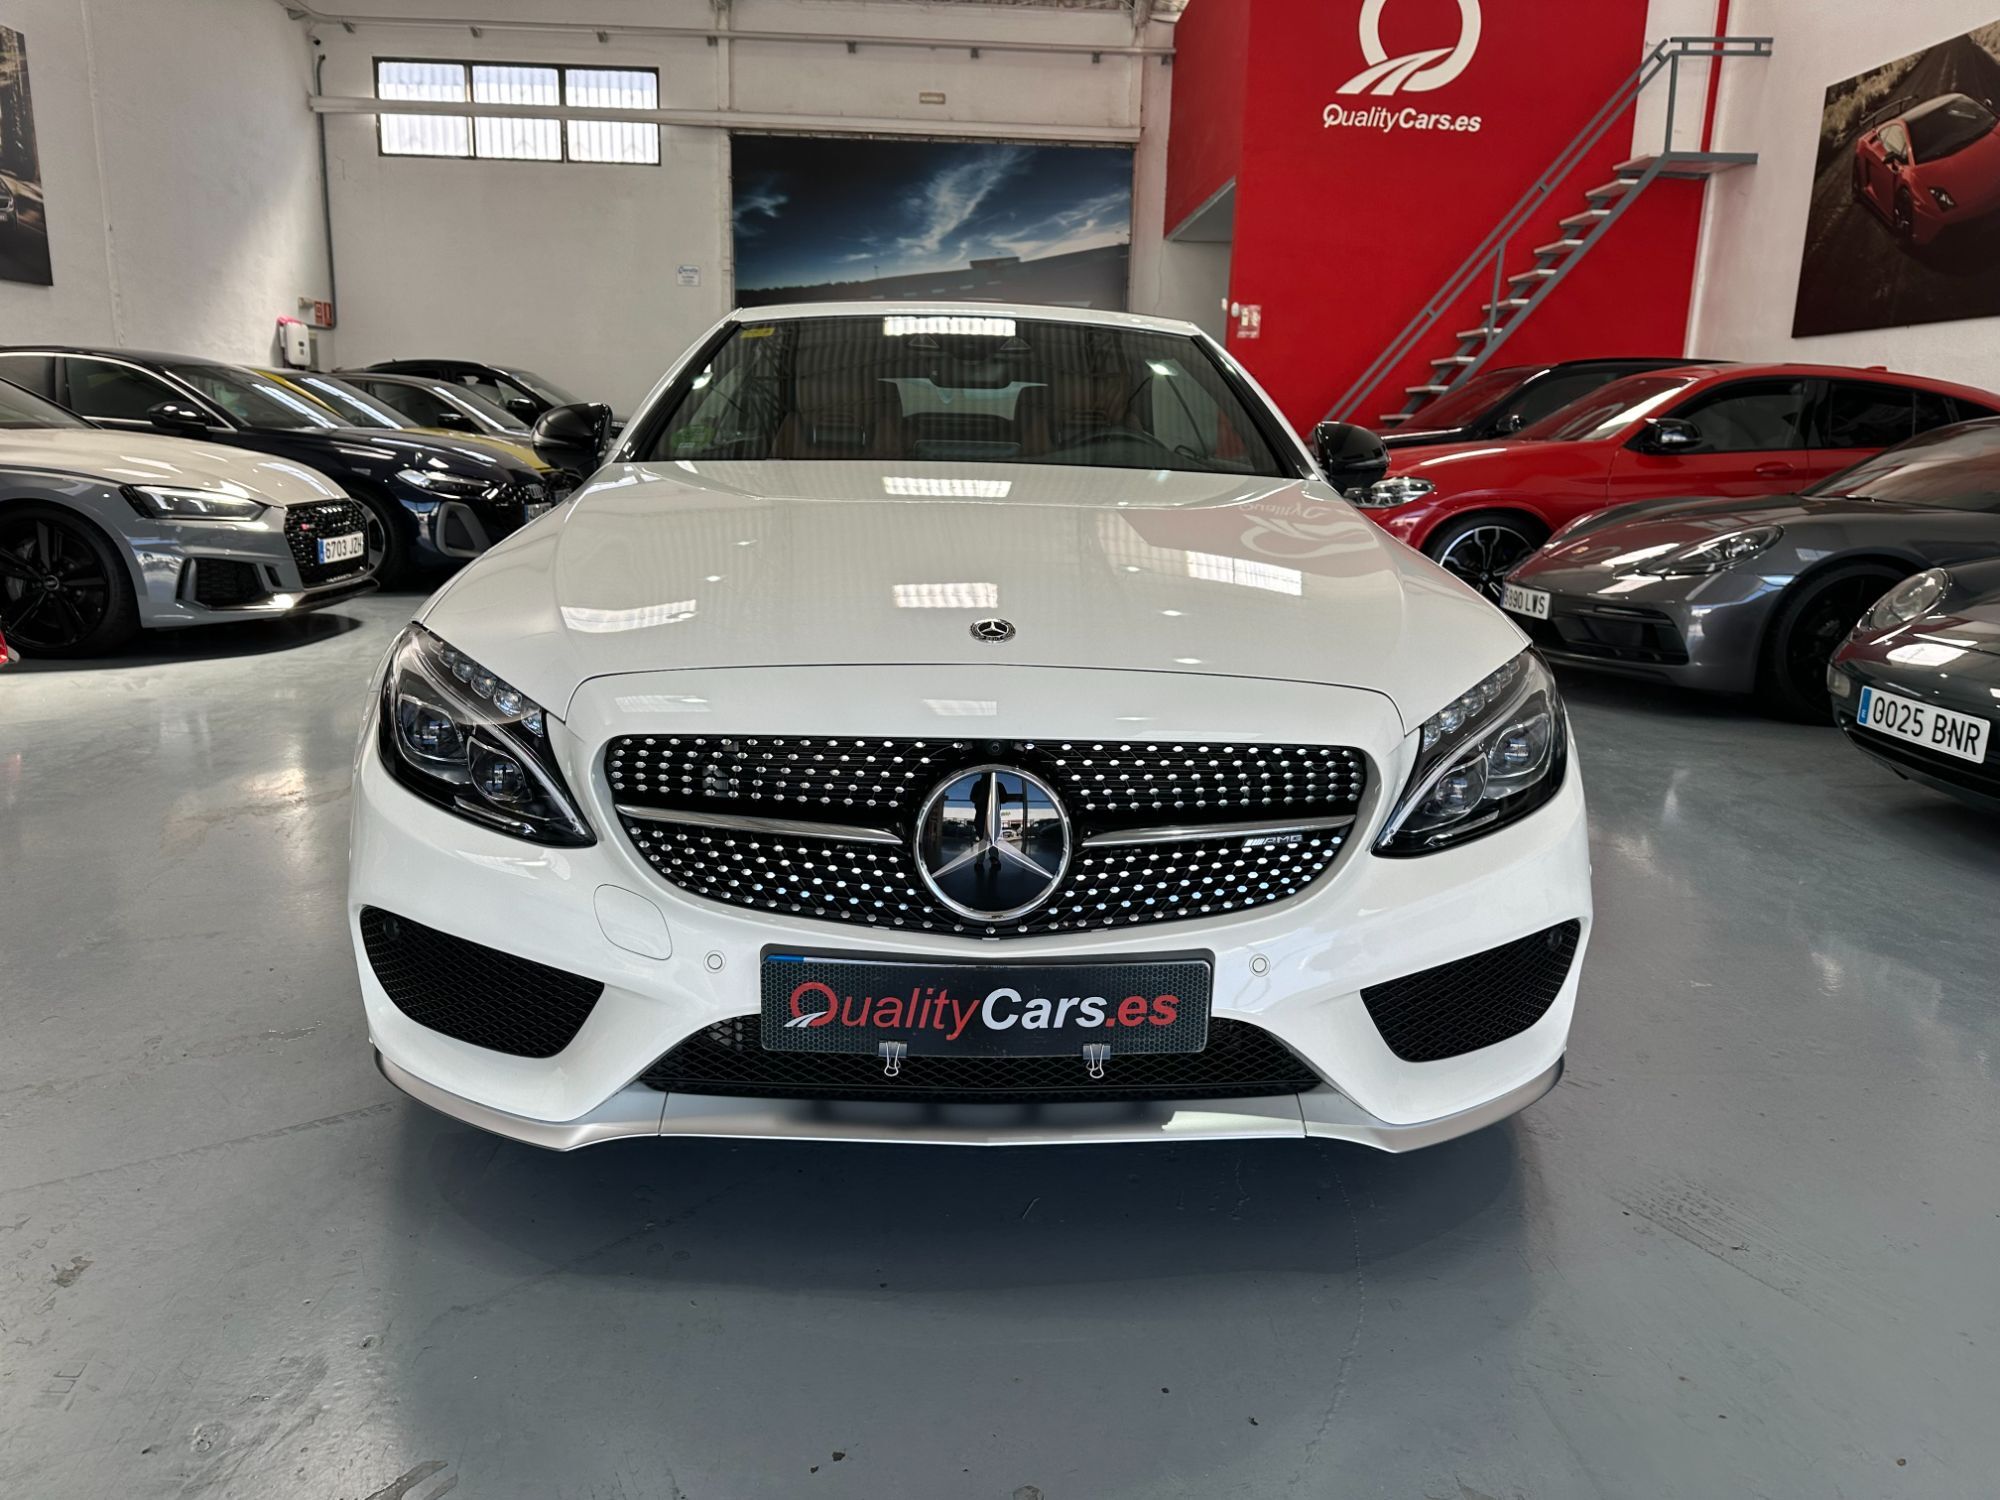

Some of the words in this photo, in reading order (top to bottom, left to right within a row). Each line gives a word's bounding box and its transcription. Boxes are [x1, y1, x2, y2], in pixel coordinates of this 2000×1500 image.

[1323, 103, 1482, 133] QualityCars.es
[325, 539, 347, 559] 6703
[1873, 696, 1924, 737] 0025
[1931, 713, 1981, 756] BNR
[784, 980, 1179, 1041] QualityCars.es
